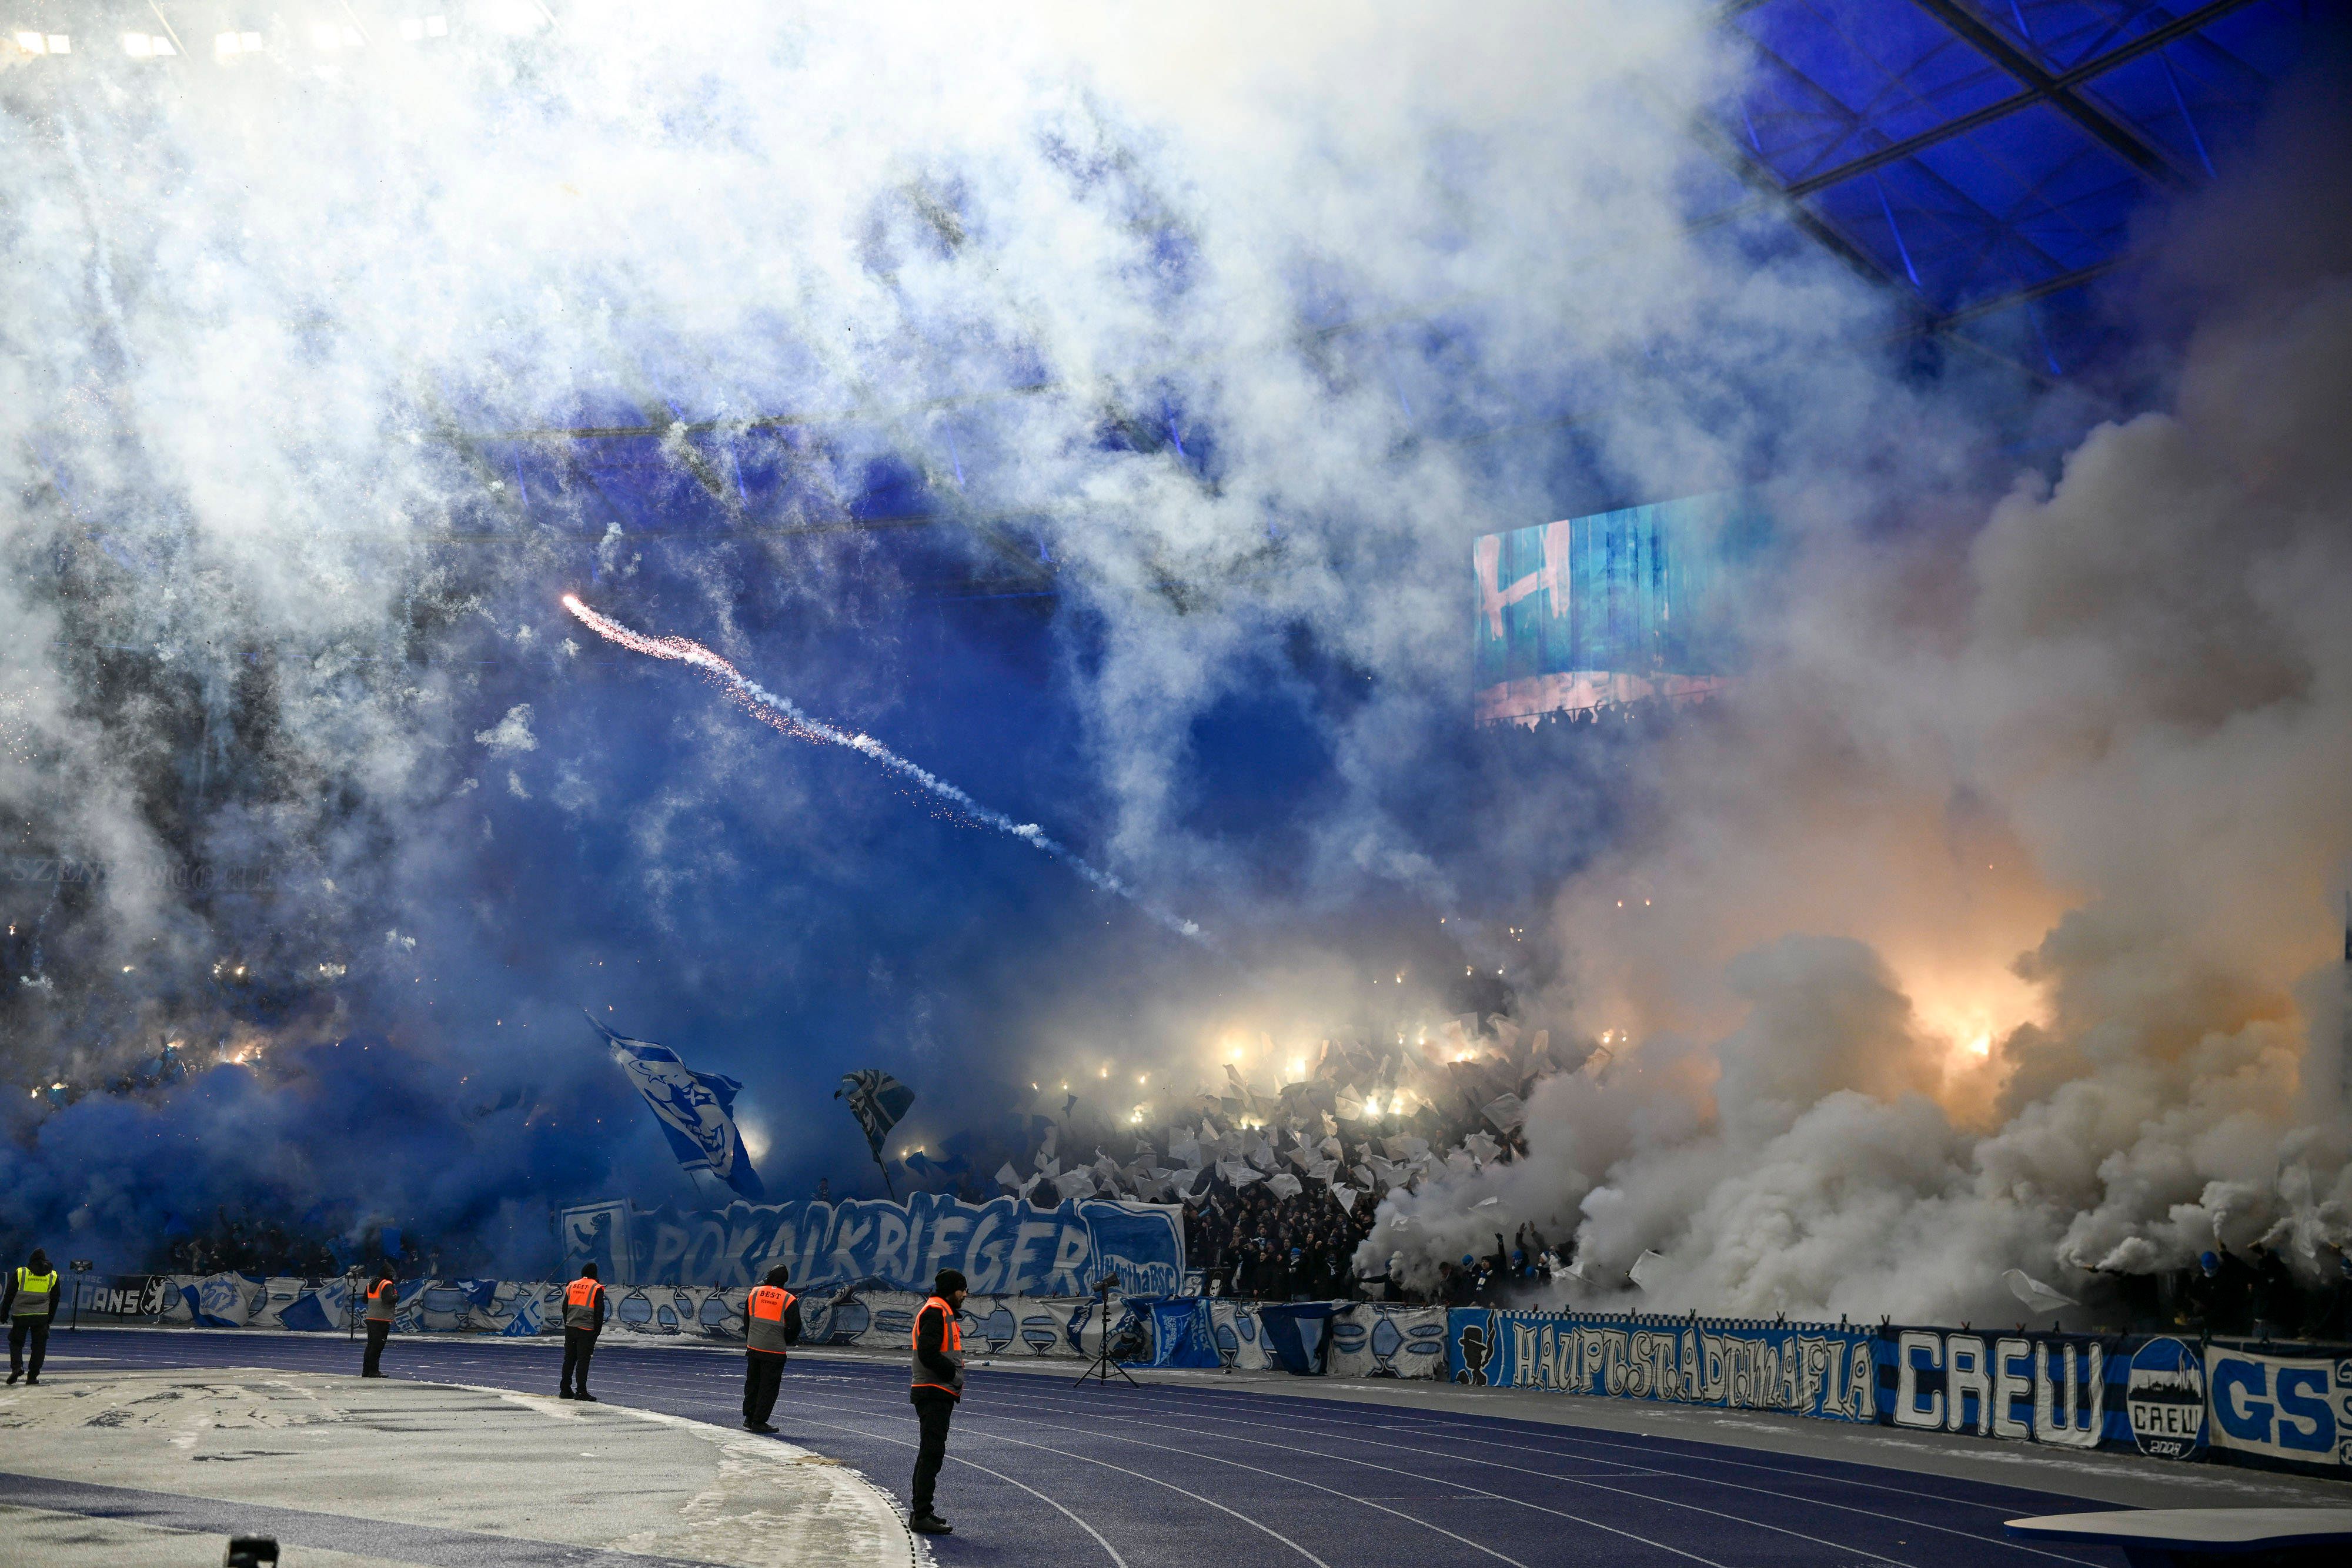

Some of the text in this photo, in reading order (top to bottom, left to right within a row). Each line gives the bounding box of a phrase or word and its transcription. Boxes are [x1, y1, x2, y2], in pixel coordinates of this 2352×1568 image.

[644, 1205, 1091, 1295] POKALKRIEGER
[1512, 1320, 1876, 1420] HAUPTSTADTMAFIA
[1893, 1329, 2104, 1448] CREW
[2211, 1357, 2336, 1453] GS
[2134, 1405, 2198, 1435] CREW
[2149, 1440, 2182, 1457] 2008
